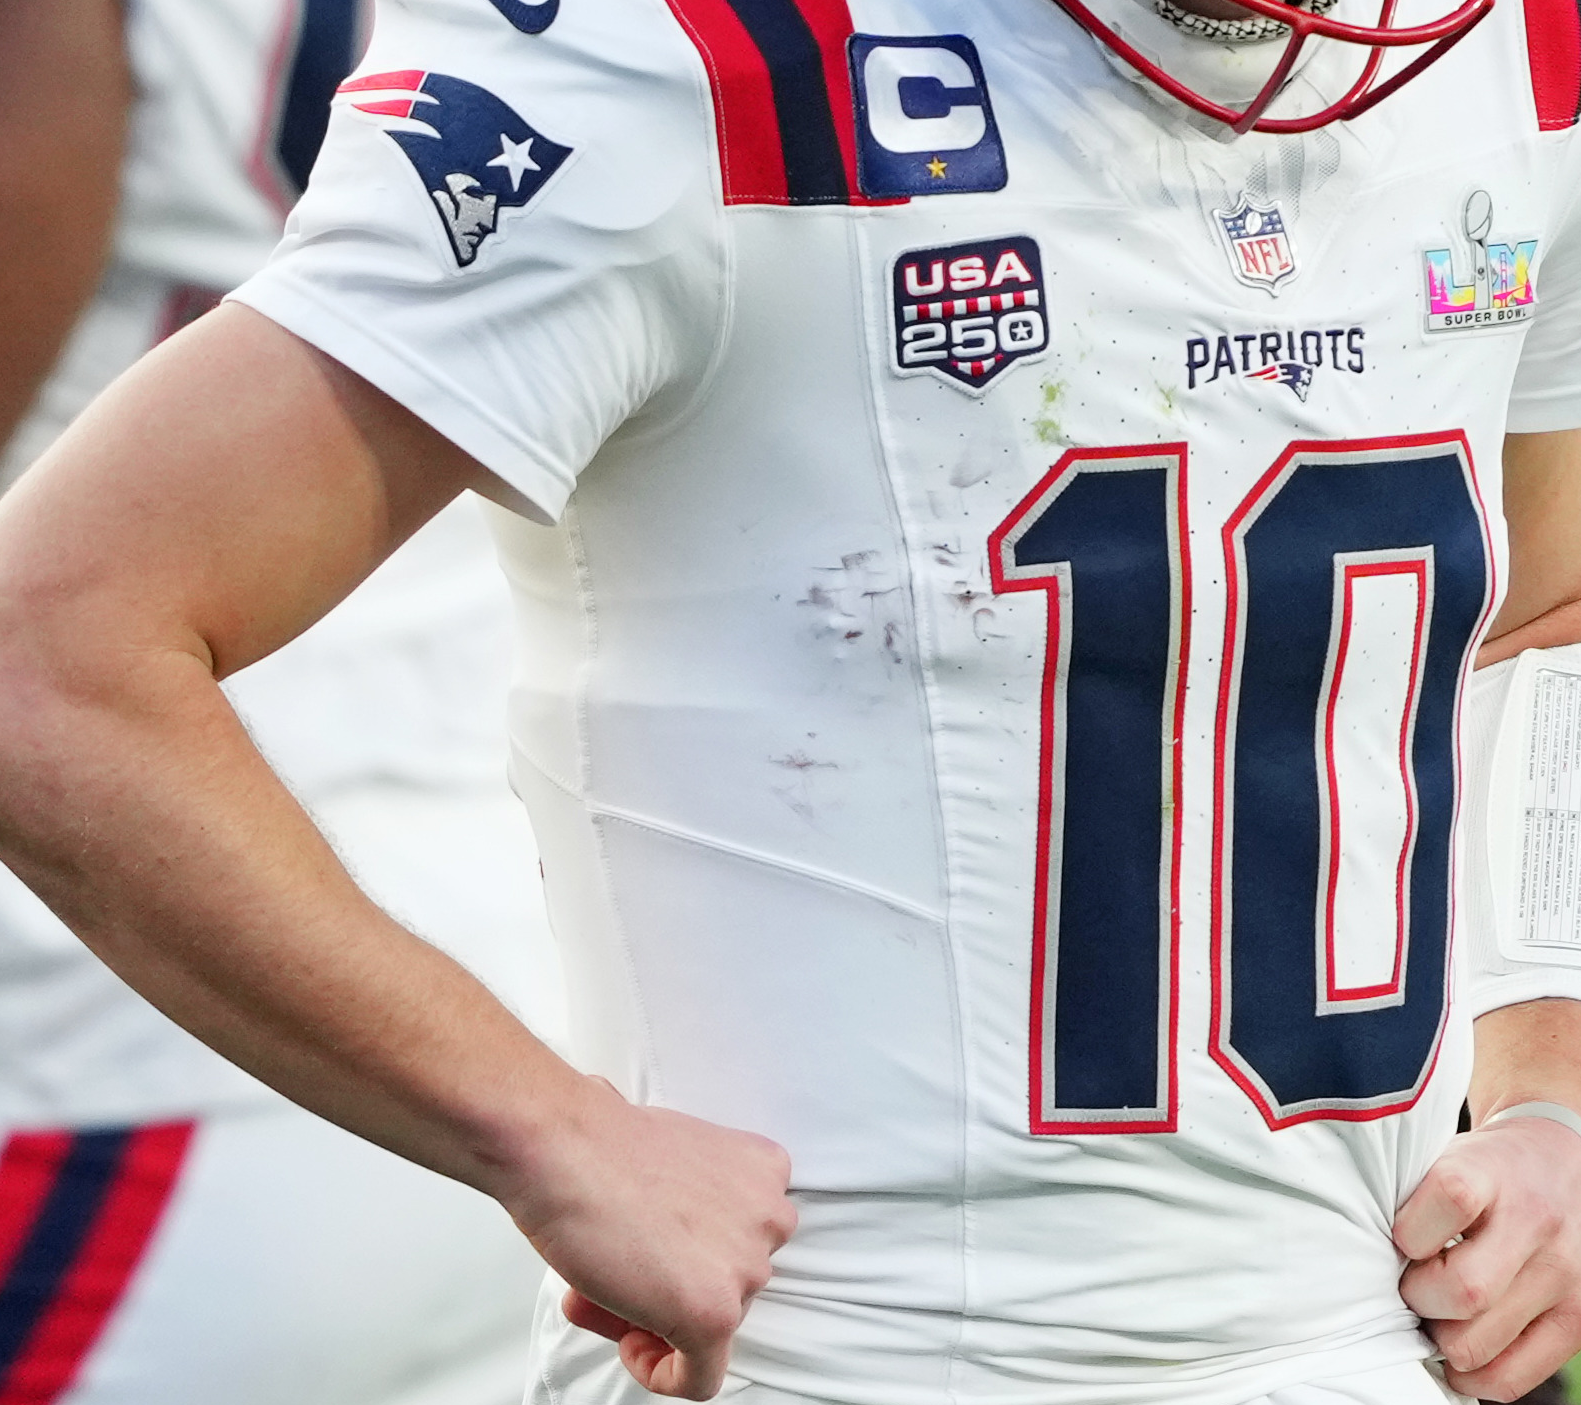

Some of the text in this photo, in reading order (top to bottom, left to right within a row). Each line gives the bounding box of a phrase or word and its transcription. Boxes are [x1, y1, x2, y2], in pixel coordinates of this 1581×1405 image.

[864, 46, 986, 153] C
[903, 250, 1033, 297] USA
[1237, 237, 1291, 276] NFL
[901, 310, 1045, 364] 250
[1444, 307, 1527, 326] SUPER BOWL
[1185, 327, 1366, 390] PATRIOTS
[988, 428, 1498, 1135] 10
